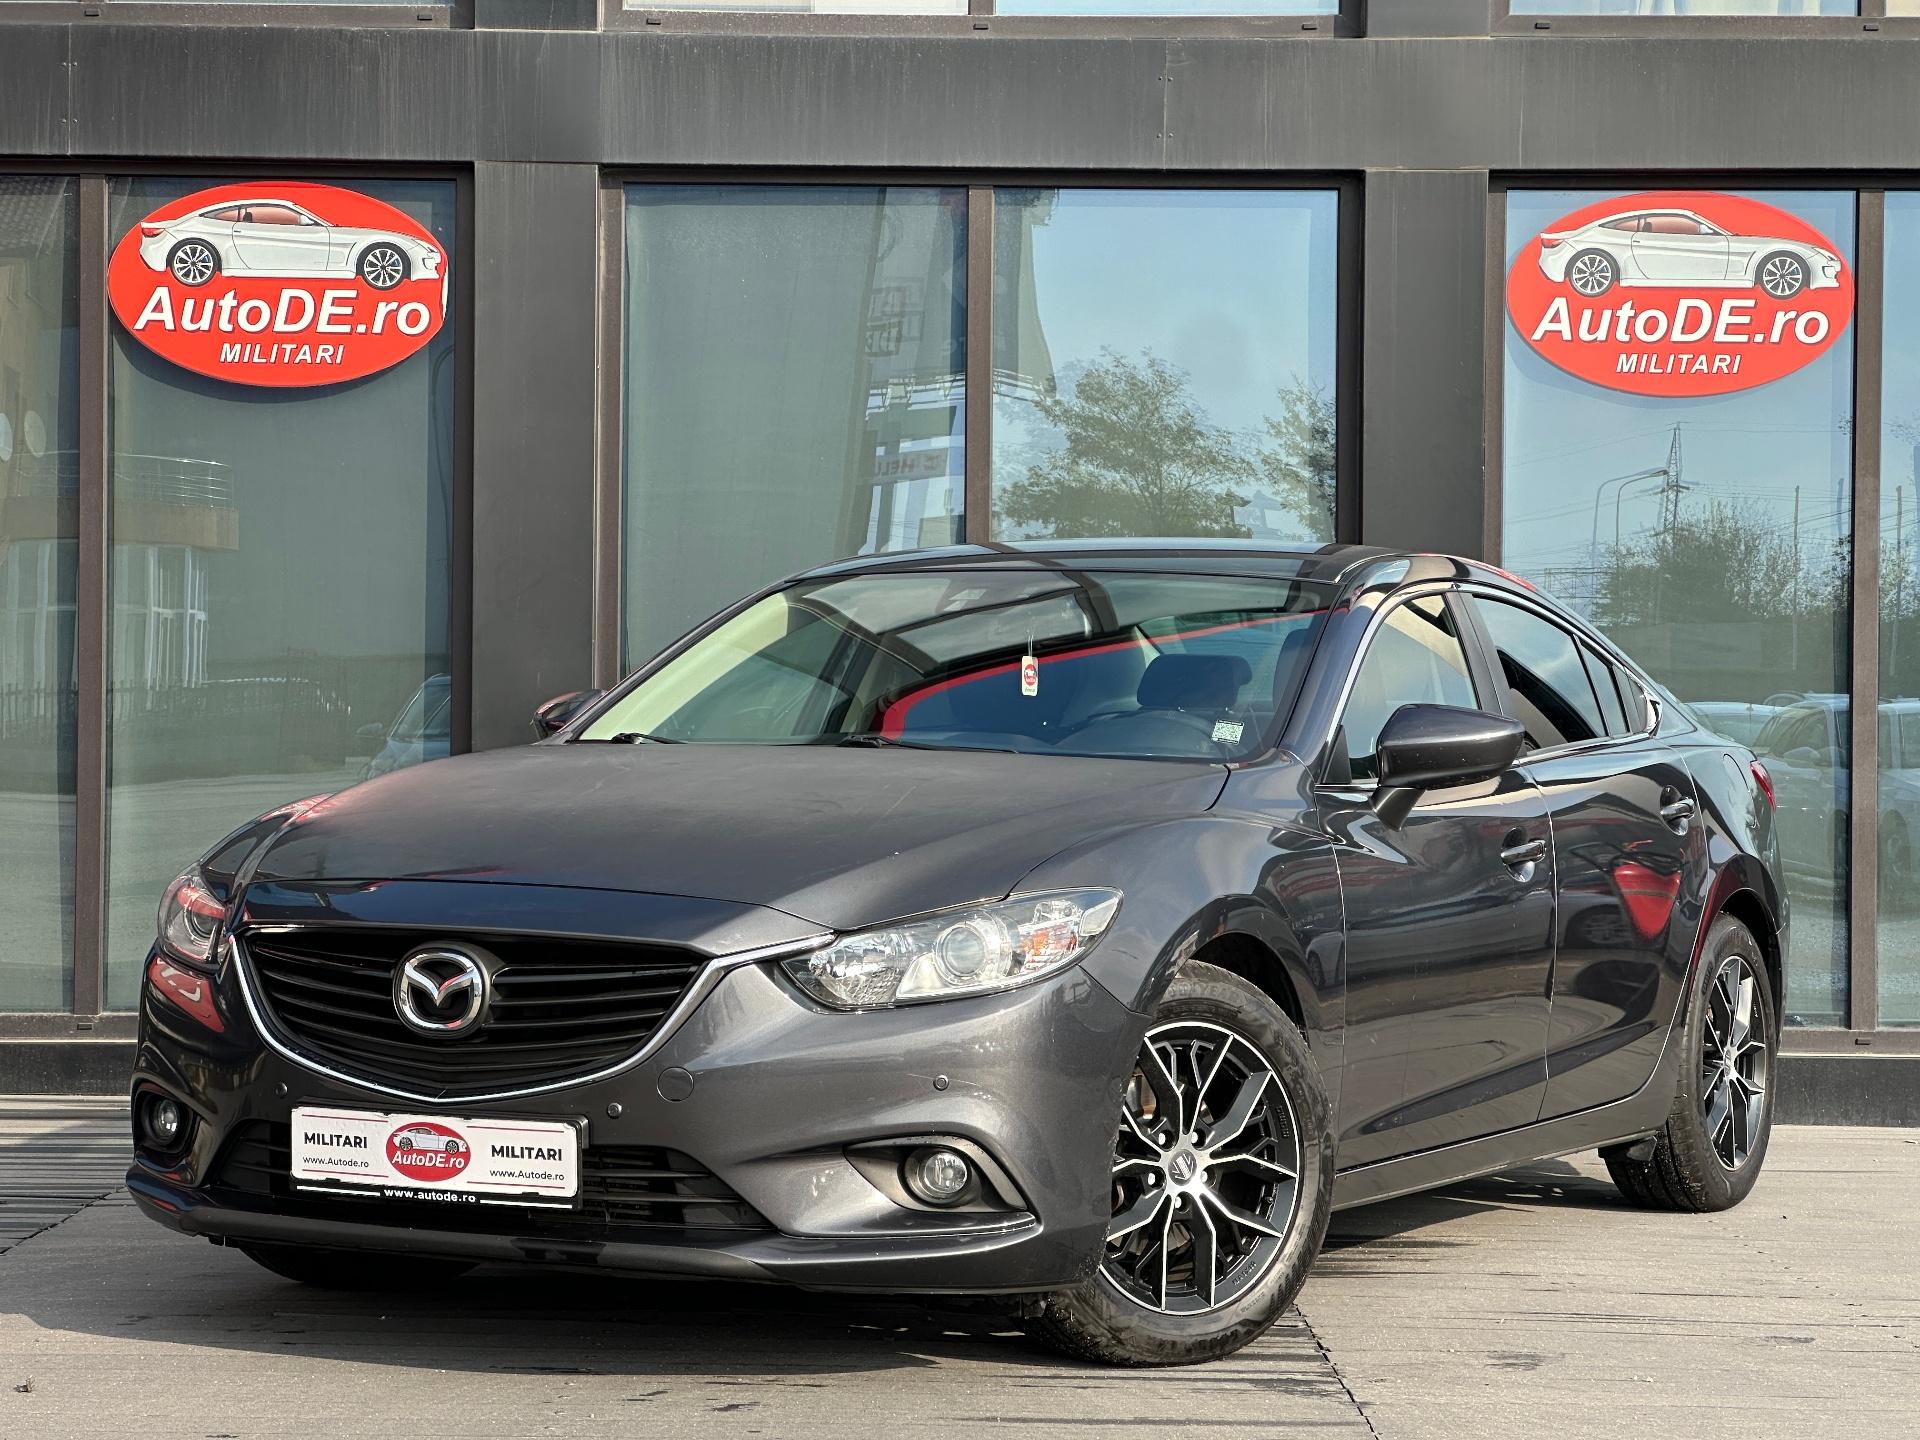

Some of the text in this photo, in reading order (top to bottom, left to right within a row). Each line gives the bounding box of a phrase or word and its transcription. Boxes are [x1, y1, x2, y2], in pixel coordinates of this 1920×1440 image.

[133, 286, 430, 335] AutoDE.ro
[1531, 297, 1829, 344] AutoDE.ro
[219, 342, 344, 364] MILITARI
[1615, 353, 1741, 374] MILITARI
[304, 1131, 368, 1149] MILITARI
[302, 1156, 369, 1168] www.Autode.ro
[391, 1150, 465, 1170] AutoDE.ro
[491, 1144, 563, 1162] MILITARI
[489, 1169, 565, 1181] www.Autode.ro
[383, 1188, 477, 1203] www.autode.ro
